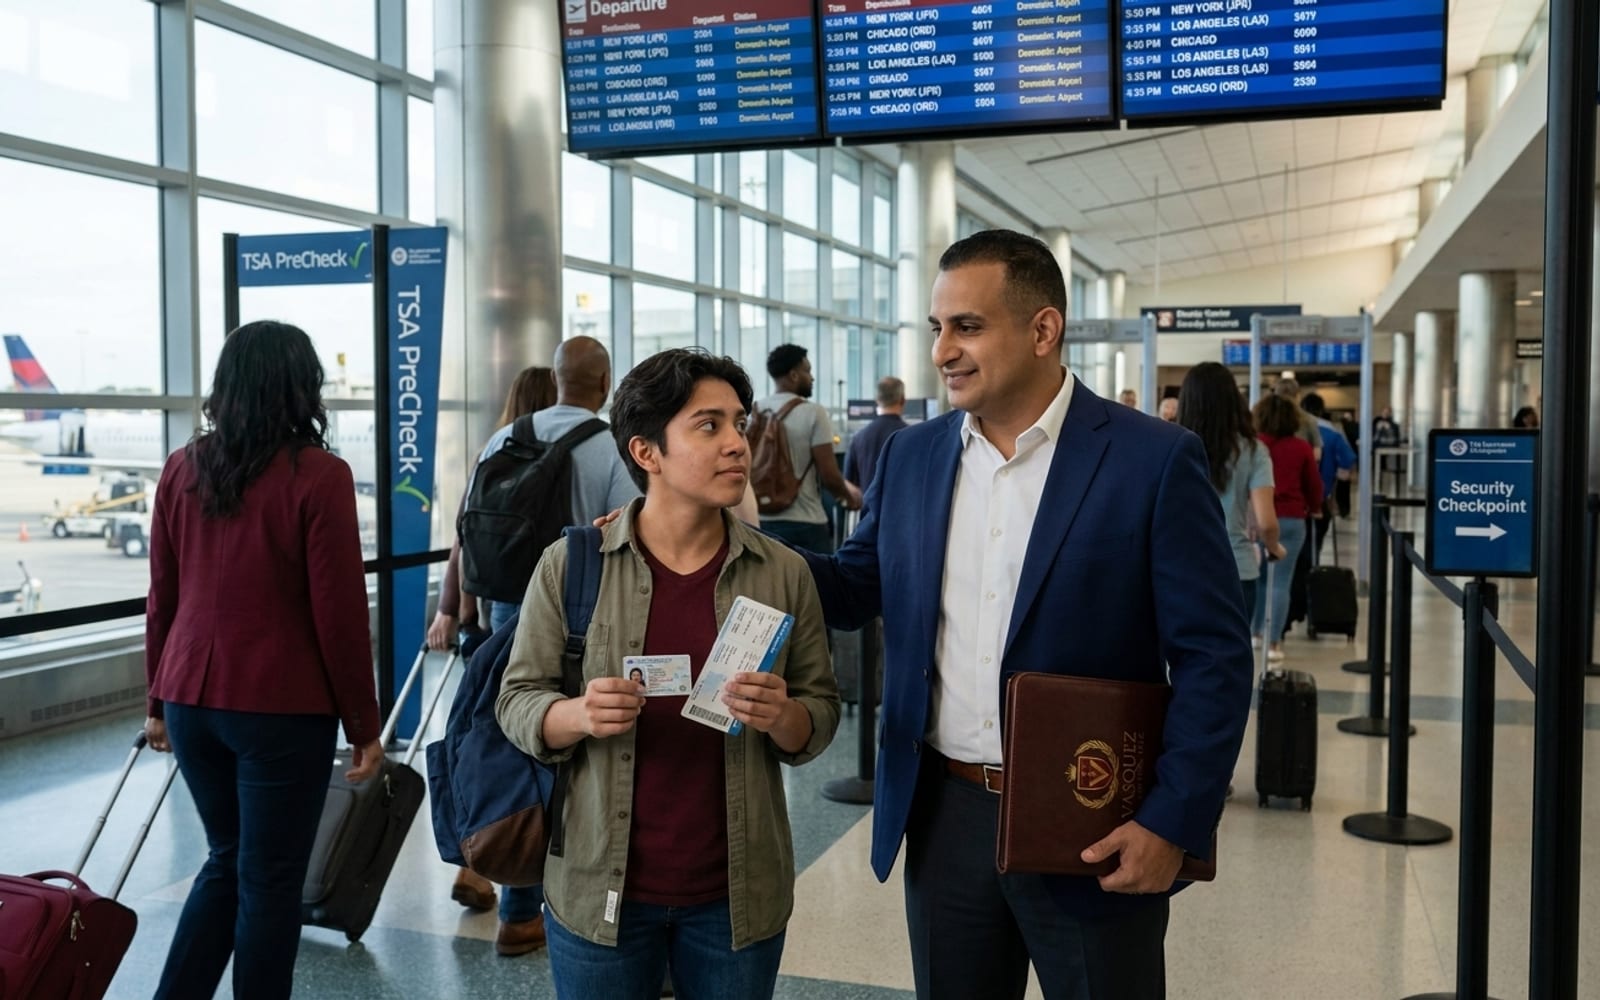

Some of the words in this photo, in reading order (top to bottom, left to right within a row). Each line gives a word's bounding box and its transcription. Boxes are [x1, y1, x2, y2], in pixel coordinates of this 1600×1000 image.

[590, 0, 667, 17] Departure
[1146, 7, 1161, 17] PM
[1171, 4, 1194, 15] NEW
[1146, 22, 1161, 32] PM
[1146, 39, 1161, 49] PM
[1146, 54, 1161, 65] PM
[1171, 52, 1191, 63] LOS
[1146, 70, 1161, 80] PM
[1171, 68, 1191, 79] LOS
[1146, 86, 1161, 96] PM
[1219, 81, 1248, 94] (ORD)
[241, 252, 272, 270] TSA
[276, 249, 348, 270] PreCheck
[398, 285, 421, 340] TSA
[398, 346, 423, 474] PreCheck
[1450, 480, 1515, 498] Security
[1438, 497, 1527, 516] Checkpoint
[1121, 731, 1138, 819] VASQUEZ
